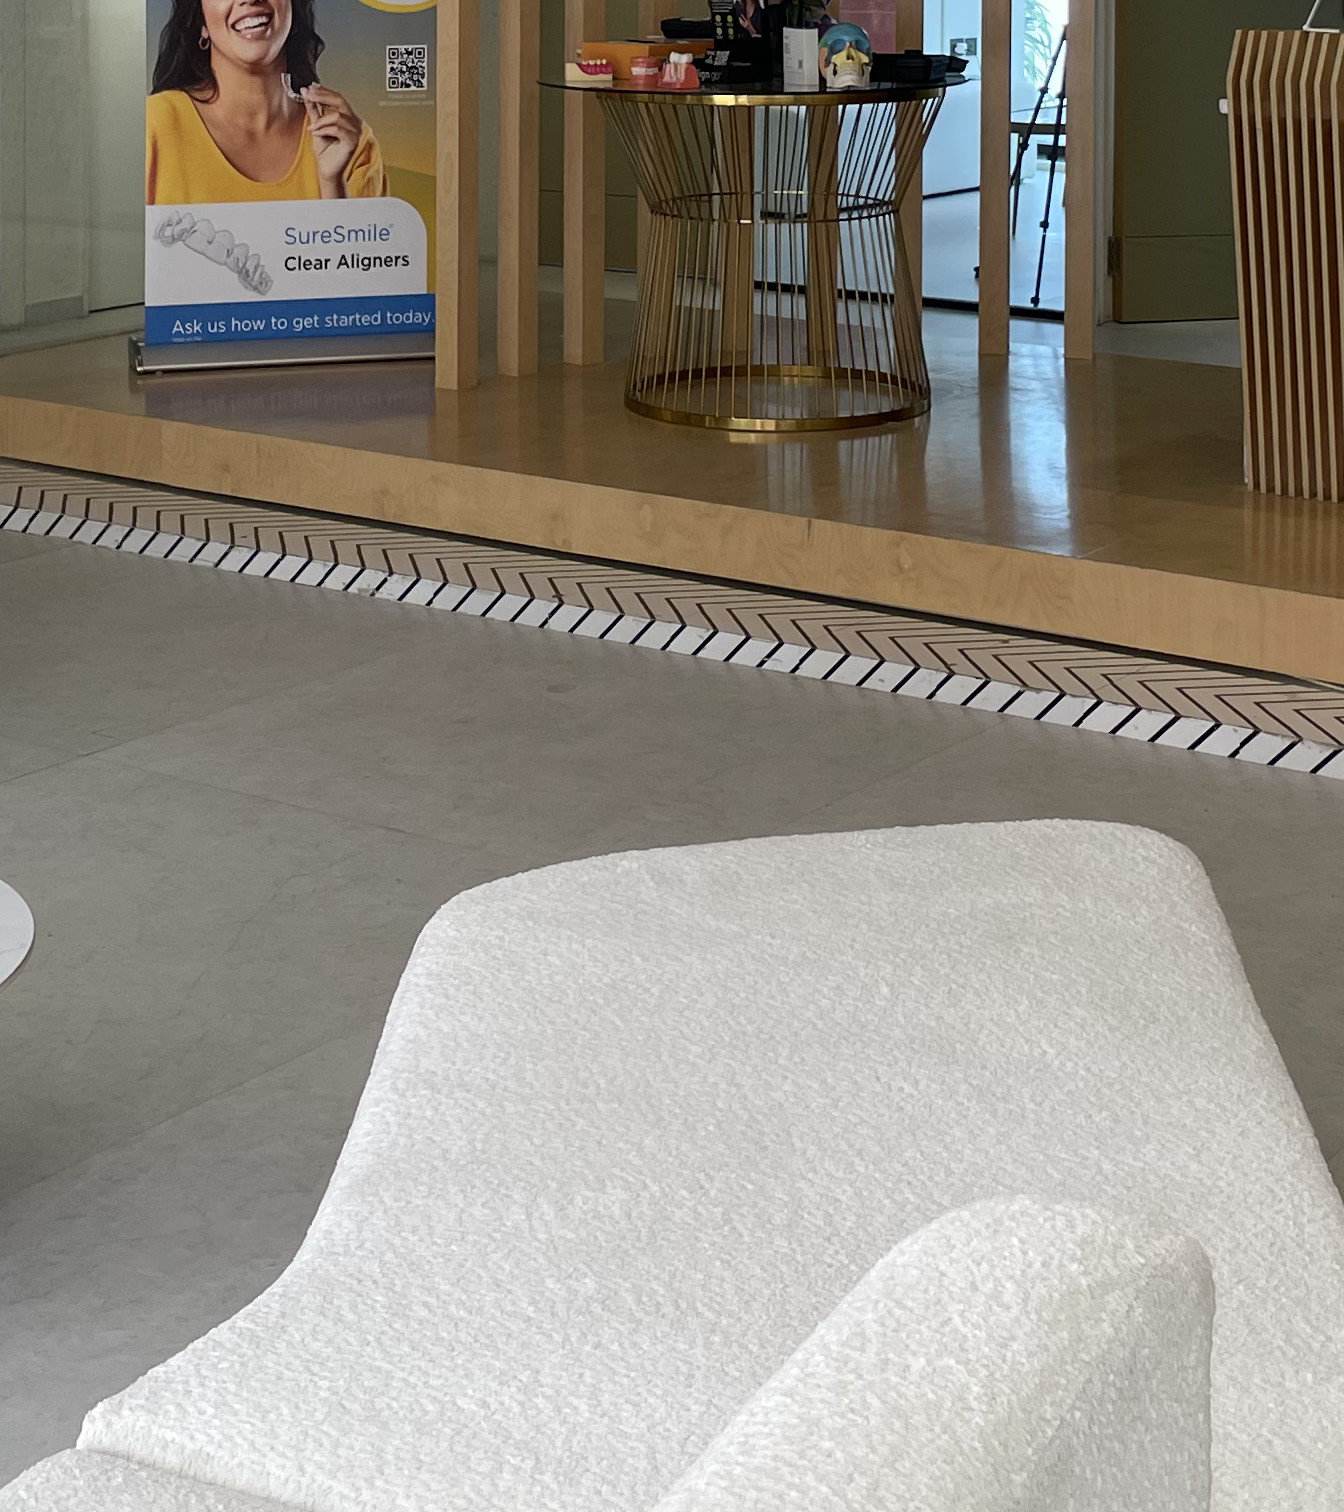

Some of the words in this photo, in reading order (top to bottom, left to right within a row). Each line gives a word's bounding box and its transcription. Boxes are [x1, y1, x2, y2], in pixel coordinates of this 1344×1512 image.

[284, 224, 391, 245] SureSmile
[284, 255, 331, 272] Clear
[336, 253, 411, 271] Aligners
[171, 319, 203, 335] Ask
[207, 321, 227, 333] us
[231, 317, 266, 332] how
[271, 316, 288, 330] to
[292, 314, 320, 332] get
[324, 310, 381, 328] started
[386, 309, 436, 326] today.
